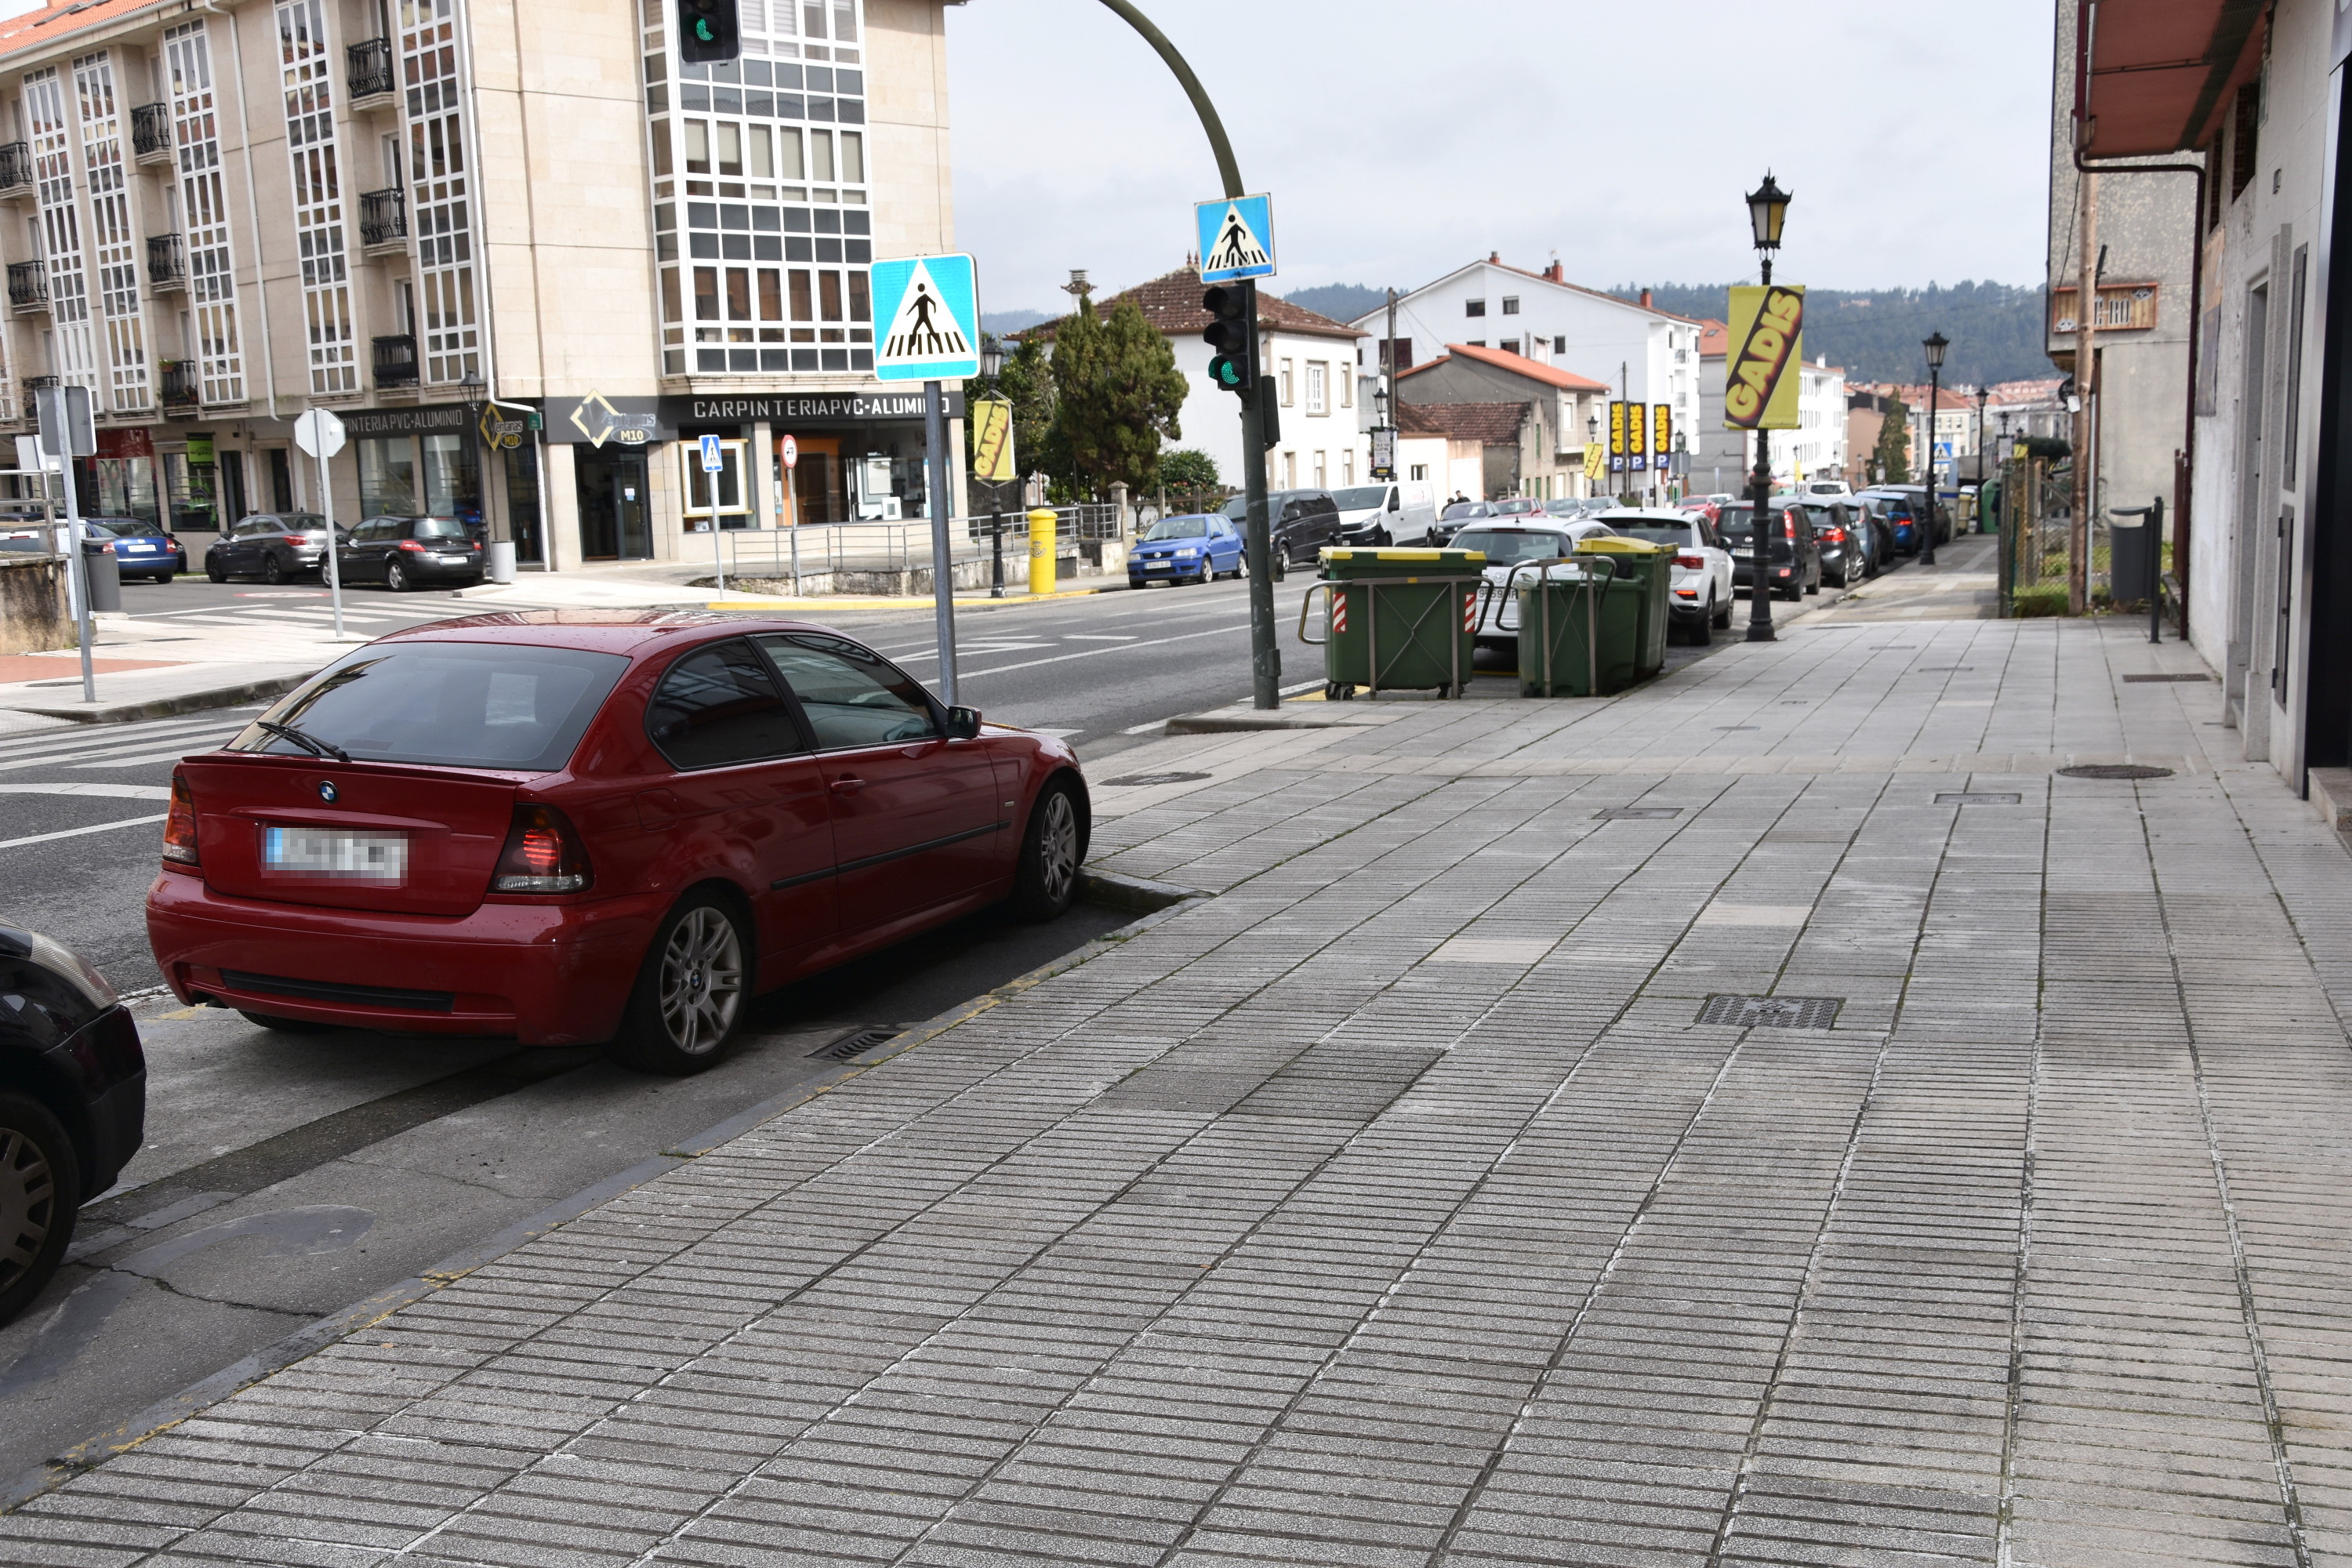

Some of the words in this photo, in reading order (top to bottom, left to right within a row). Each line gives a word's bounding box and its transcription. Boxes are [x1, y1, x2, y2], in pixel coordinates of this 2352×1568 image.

[1726, 290, 1802, 420] GADIS
[694, 400, 829, 418] CARPINTERIA
[343, 415, 389, 433] PINTERIA
[1611, 402, 1624, 454] GADIS
[1630, 405, 1643, 454] GADIS
[1655, 405, 1668, 452] GADIS
[504, 435, 518, 445] M10
[620, 430, 644, 441] M10
[975, 405, 1009, 477] GADIS
[1632, 456, 1642, 470] P
[1657, 455, 1668, 467] P
